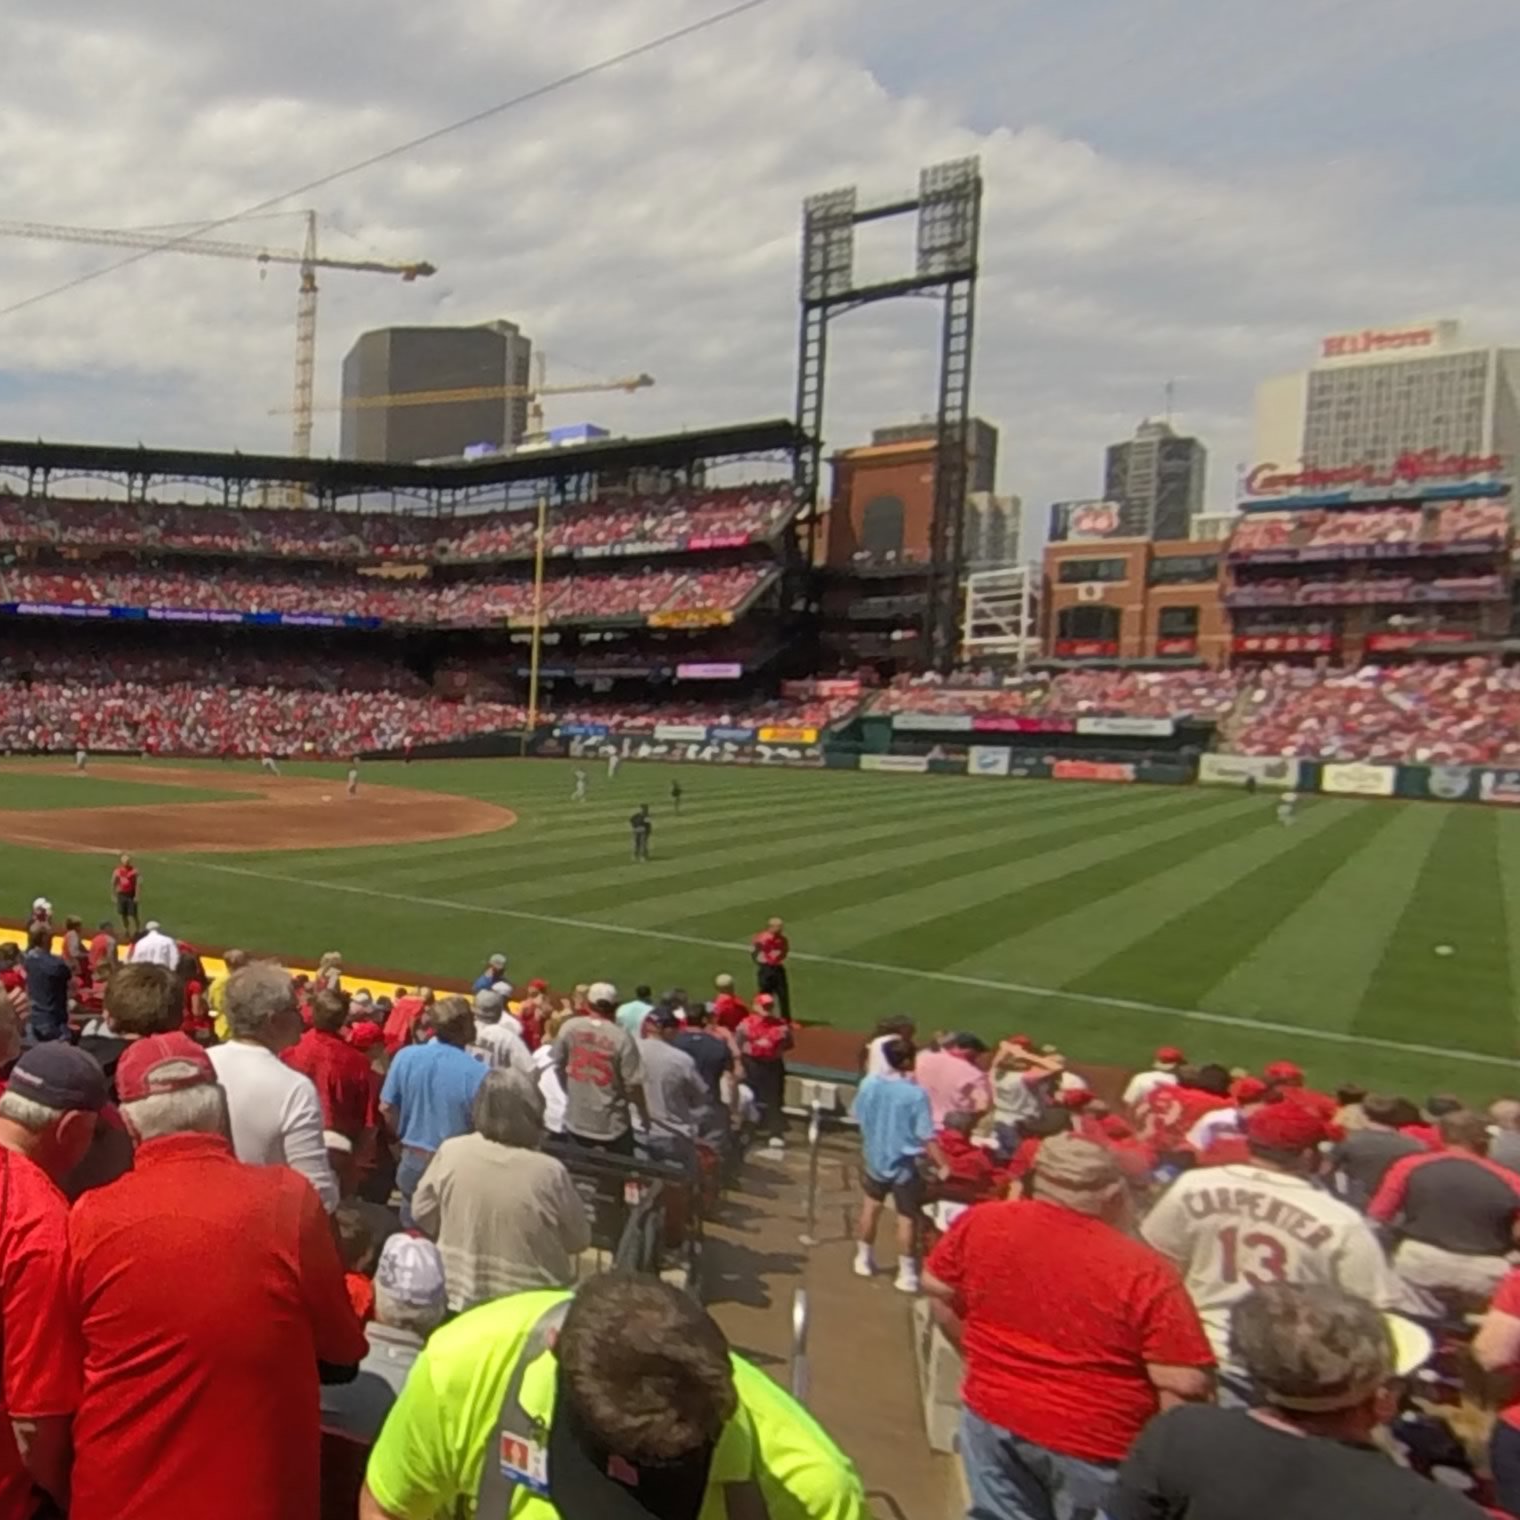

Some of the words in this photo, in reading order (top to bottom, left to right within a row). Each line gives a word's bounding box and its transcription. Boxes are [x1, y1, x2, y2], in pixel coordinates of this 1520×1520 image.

[1322, 328, 1435, 358] Hilton
[1182, 1187, 1335, 1250] CARPENTER
[1218, 1225, 1289, 1287] 13
